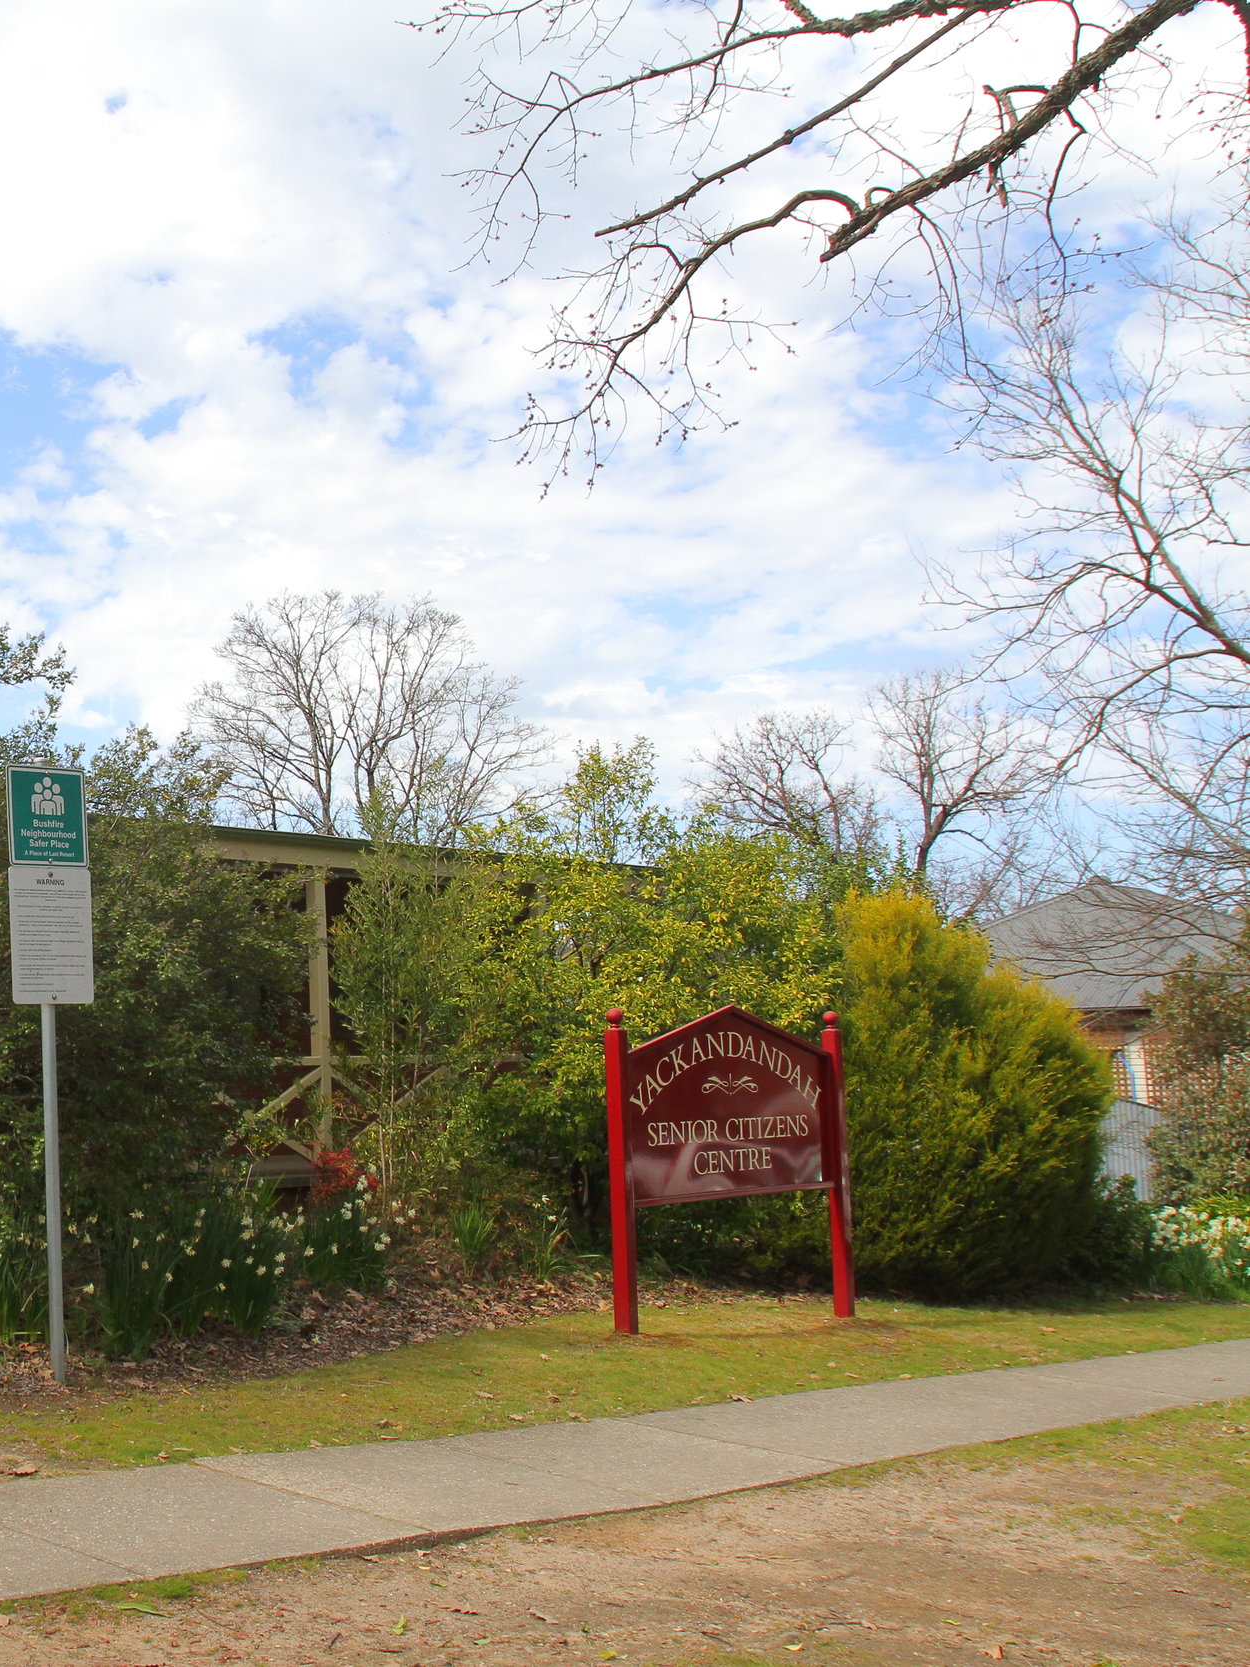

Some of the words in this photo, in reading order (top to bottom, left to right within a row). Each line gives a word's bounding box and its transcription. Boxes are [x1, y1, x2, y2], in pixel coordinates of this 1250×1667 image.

[33, 819, 64, 828] Bushfire
[21, 829, 76, 839] Neighbourhood
[29, 839, 48, 847] Safer
[50, 840, 69, 848] Place
[630, 1032, 822, 1115] YACKANDANDAH
[647, 1120, 719, 1147] SENIOR
[725, 1114, 809, 1142] CITIZENS
[693, 1147, 772, 1175] CENTRE
